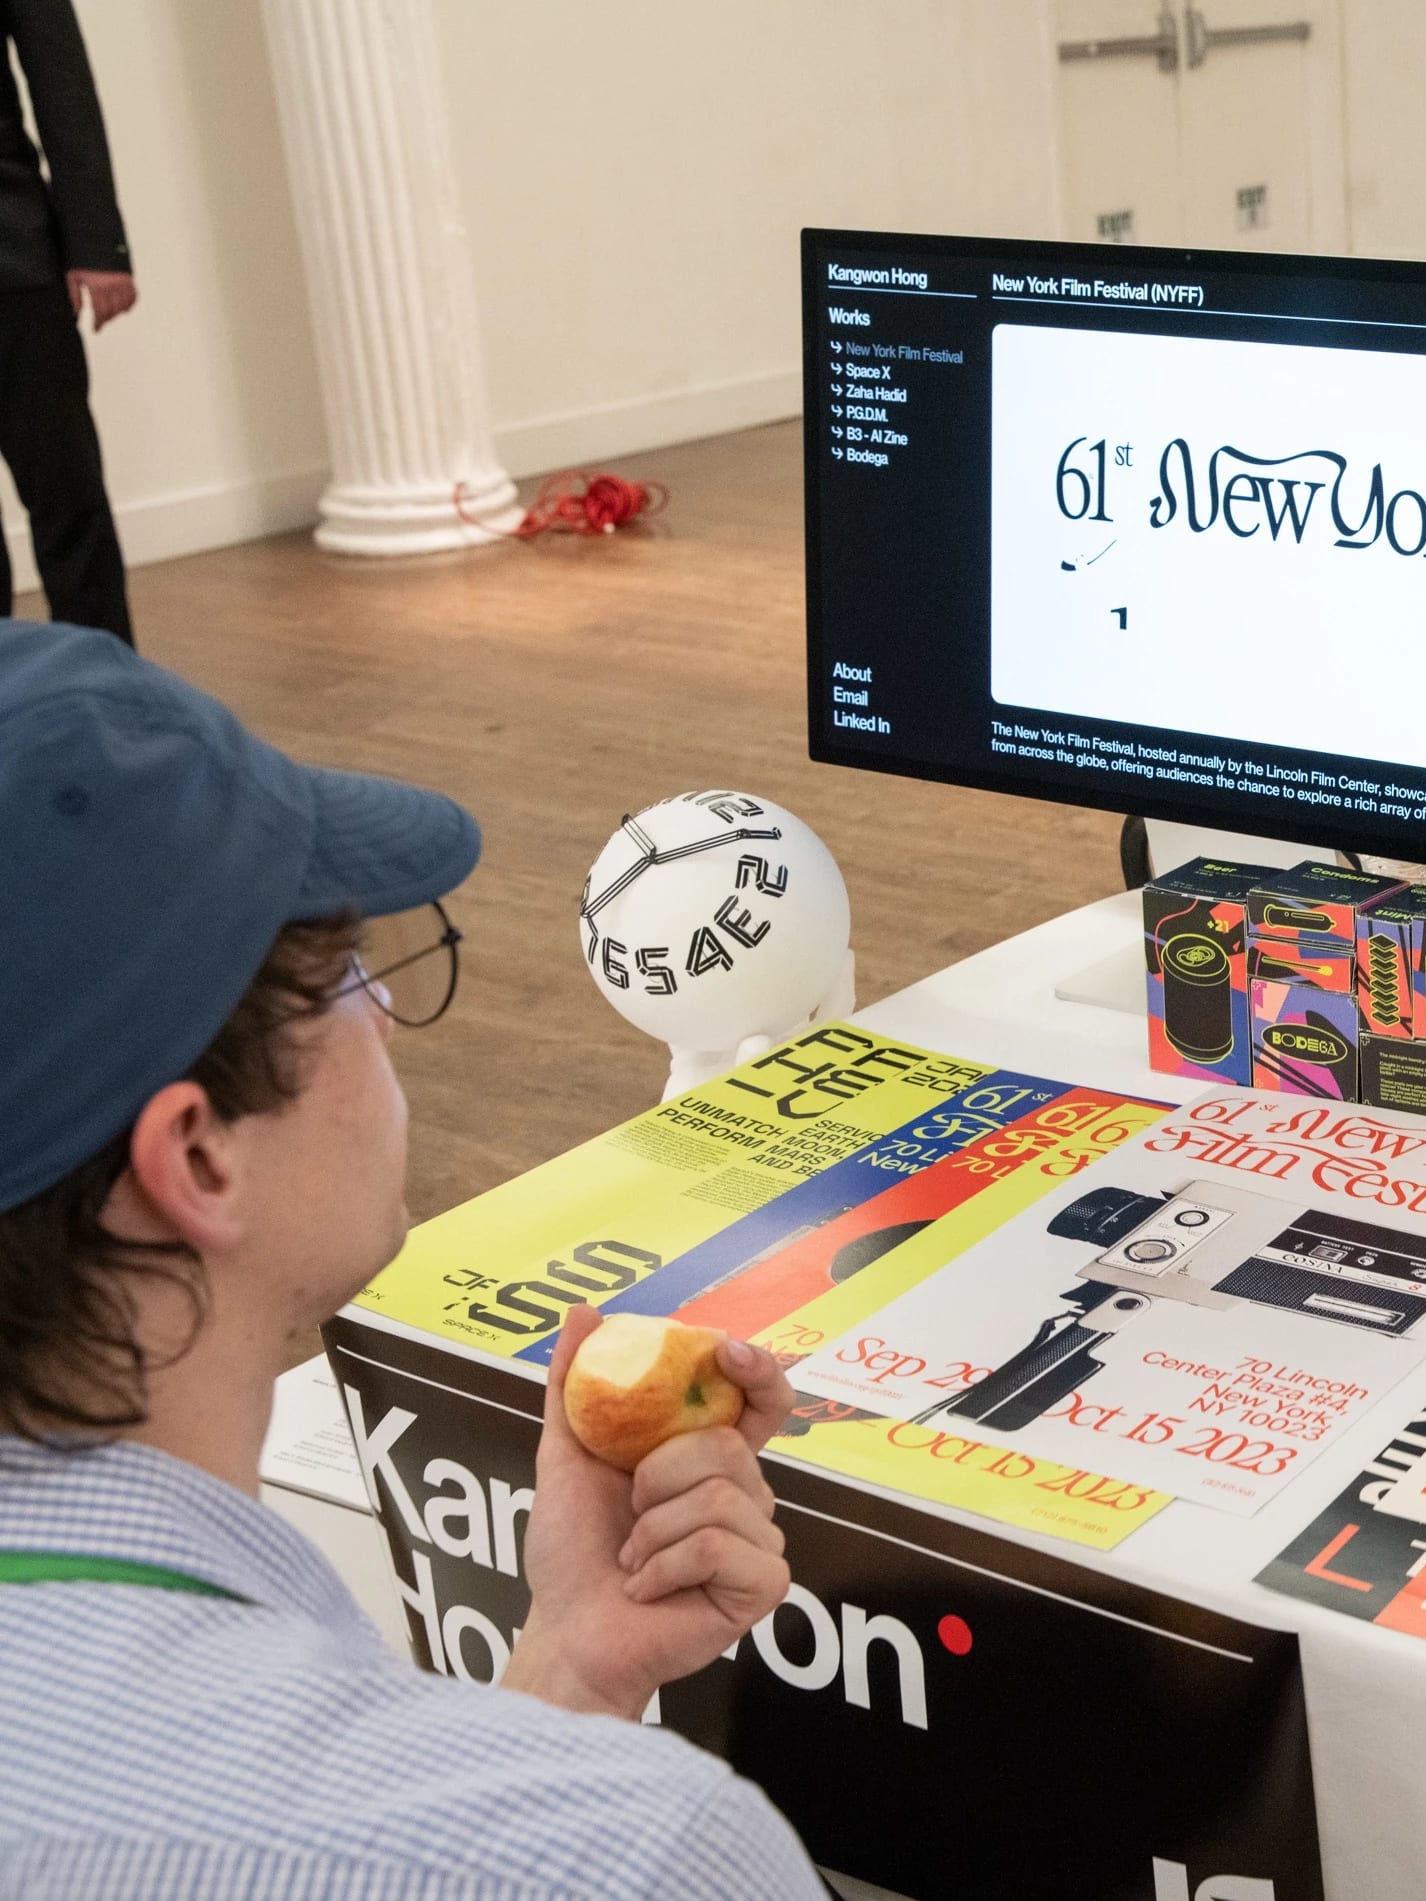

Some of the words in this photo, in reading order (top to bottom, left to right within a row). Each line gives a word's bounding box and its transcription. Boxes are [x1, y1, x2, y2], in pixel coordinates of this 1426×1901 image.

[828, 264, 890, 286] Kangwon
[891, 269, 928, 289] Hong
[992, 275, 1022, 293] New
[1025, 277, 1058, 295] York
[1061, 279, 1091, 297] Film
[1094, 281, 1148, 301] Festival
[1151, 283, 1203, 306] (NYFF)
[828, 307, 870, 326] Works
[846, 342, 870, 357] New
[873, 344, 896, 359] York
[899, 346, 921, 360] Film
[923, 348, 963, 364] Festival
[846, 363, 880, 380] Space
[882, 366, 890, 379] X
[846, 385, 873, 400] Zaha
[875, 387, 906, 402] Hadid
[846, 427, 863, 440] B3
[885, 430, 907, 445] Zine
[847, 449, 888, 466] Bodega
[1150, 439, 1326, 544] New
[833, 662, 872, 683] About
[833, 687, 868, 706] Email
[834, 711, 876, 731] Linked
[879, 719, 890, 734] In
[992, 721, 1012, 736] The
[1015, 725, 1038, 741] New
[1041, 729, 1064, 745] York
[1067, 733, 1090, 749] Film
[1092, 736, 1136, 757] Festival,
[1138, 744, 1176, 761] hosted
[1179, 748, 1226, 772] annually
[1228, 758, 1242, 774] by
[1245, 761, 1263, 775] the
[1266, 764, 1308, 782] Lincoln
[1311, 771, 1335, 788] Film
[1338, 775, 1381, 796] Center,
[992, 739, 1016, 754] from
[1018, 744, 1054, 761] across
[1057, 748, 1074, 763] the
[1076, 751, 1108, 770] globe,
[1111, 756, 1153, 778] offering
[1156, 764, 1213, 786] audiences
[1216, 774, 1234, 789] the
[1237, 778, 1279, 797] chance
[1283, 783, 1294, 798] to
[1297, 787, 1341, 808] explore
[1344, 796, 1352, 808] a
[1355, 795, 1377, 812] rich
[1380, 802, 1411, 820] array
[1414, 805, 1426, 820] of
[1204, 863, 1237, 873] Beer
[1311, 867, 1380, 885] Condoms
[1272, 1031, 1338, 1057] BODEGA
[766, 1145, 826, 1165] MARS
[880, 1139, 921, 1157] 70
[1144, 1125, 1302, 1179] Film
[749, 1153, 794, 1169] AND
[952, 1156, 996, 1174] 70
[1282, 1253, 1343, 1273] COSINA
[777, 1324, 824, 1346] 70
[1142, 1351, 1233, 1382] Center
[1232, 1373, 1306, 1402] Plaza
[1235, 1356, 1272, 1375] 70
[1277, 1366, 1368, 1401] Lincoln
[836, 1336, 926, 1384] Sep
[1119, 1413, 1187, 1445] 15
[1175, 1428, 1298, 1476] 2023
[1201, 1383, 1269, 1408] New
[1189, 1398, 1234, 1417] NY
[1238, 1410, 1326, 1442] 10023
